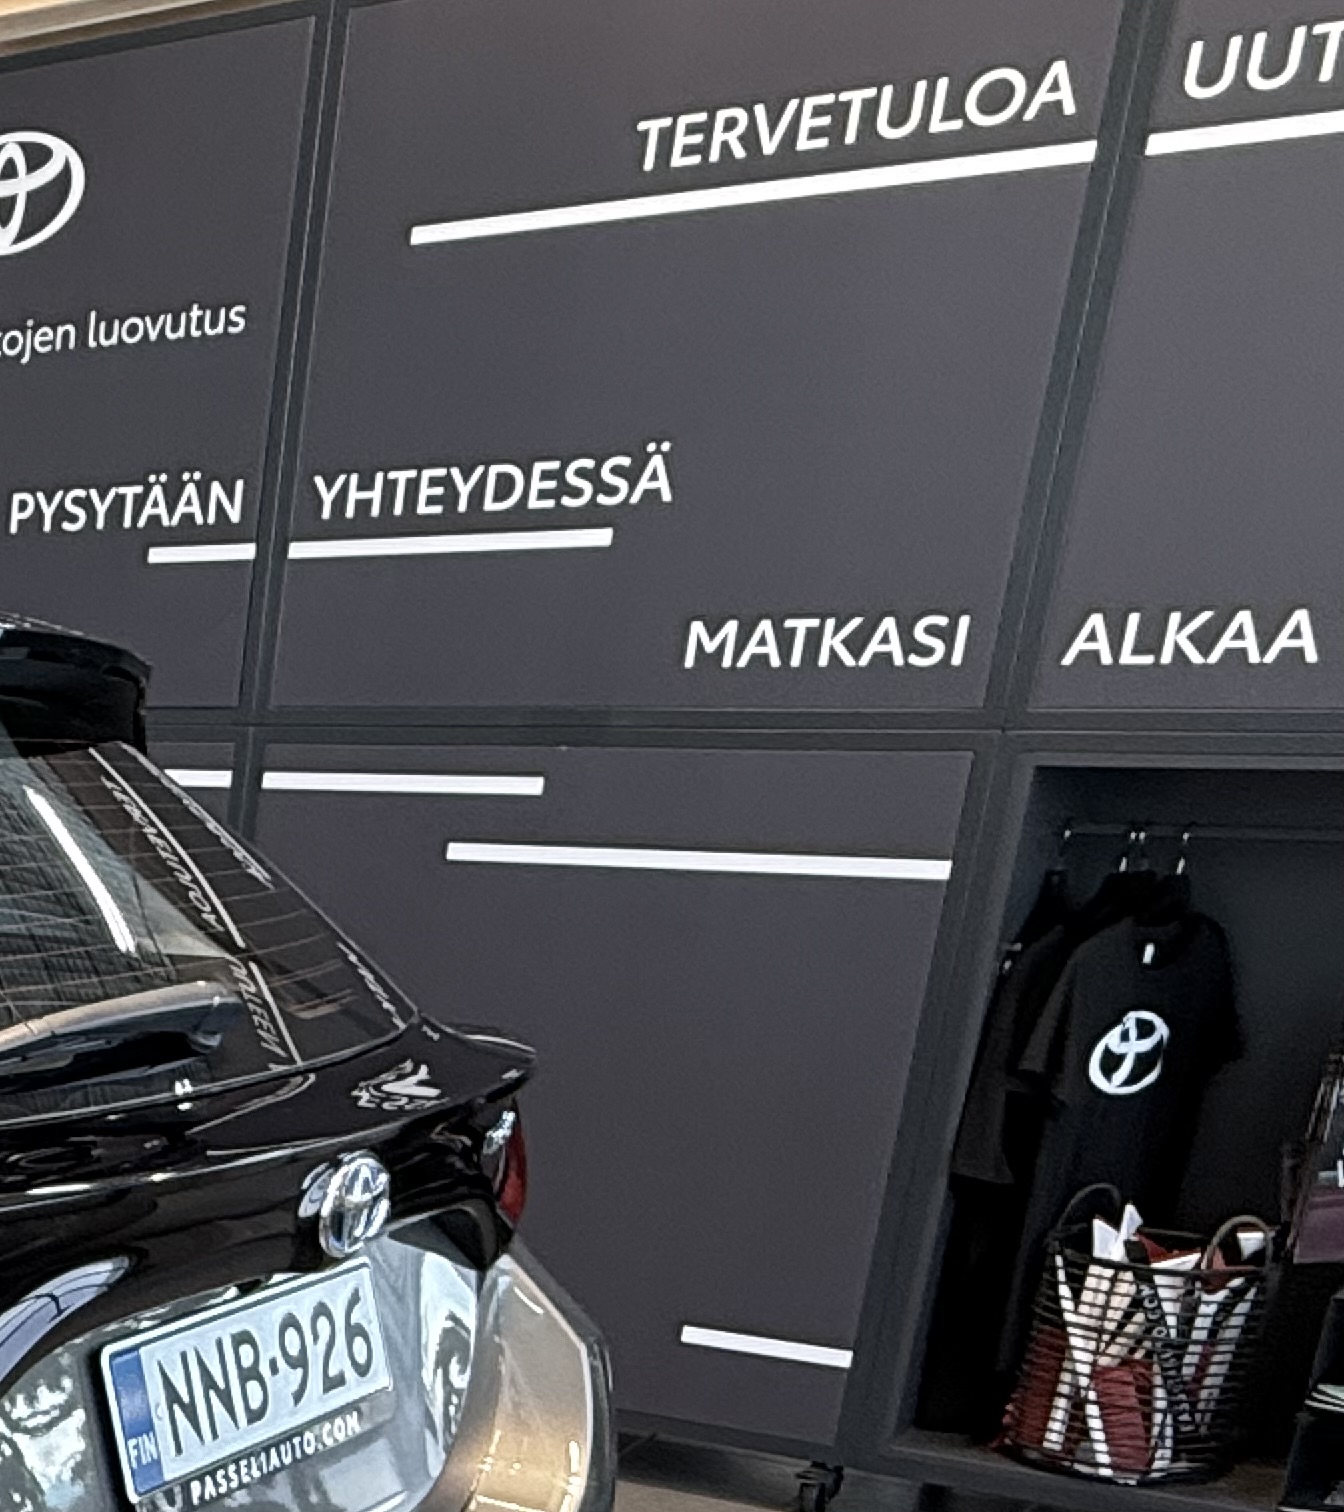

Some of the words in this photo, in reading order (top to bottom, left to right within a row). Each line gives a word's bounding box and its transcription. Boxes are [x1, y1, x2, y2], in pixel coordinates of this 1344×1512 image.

[636, 59, 1076, 172] TERVETULOA
[1183, 20, 1344, 100] UUT
[86, 302, 247, 349] luovutus
[9, 471, 245, 534] PYSYTÄÄN
[313, 442, 673, 521] YHTEYDESSÄ
[683, 615, 971, 668] MATKASI
[1060, 608, 1318, 667] ALKAA
[157, 1286, 373, 1457] NNB-926
[127, 1433, 159, 1469] FIN
